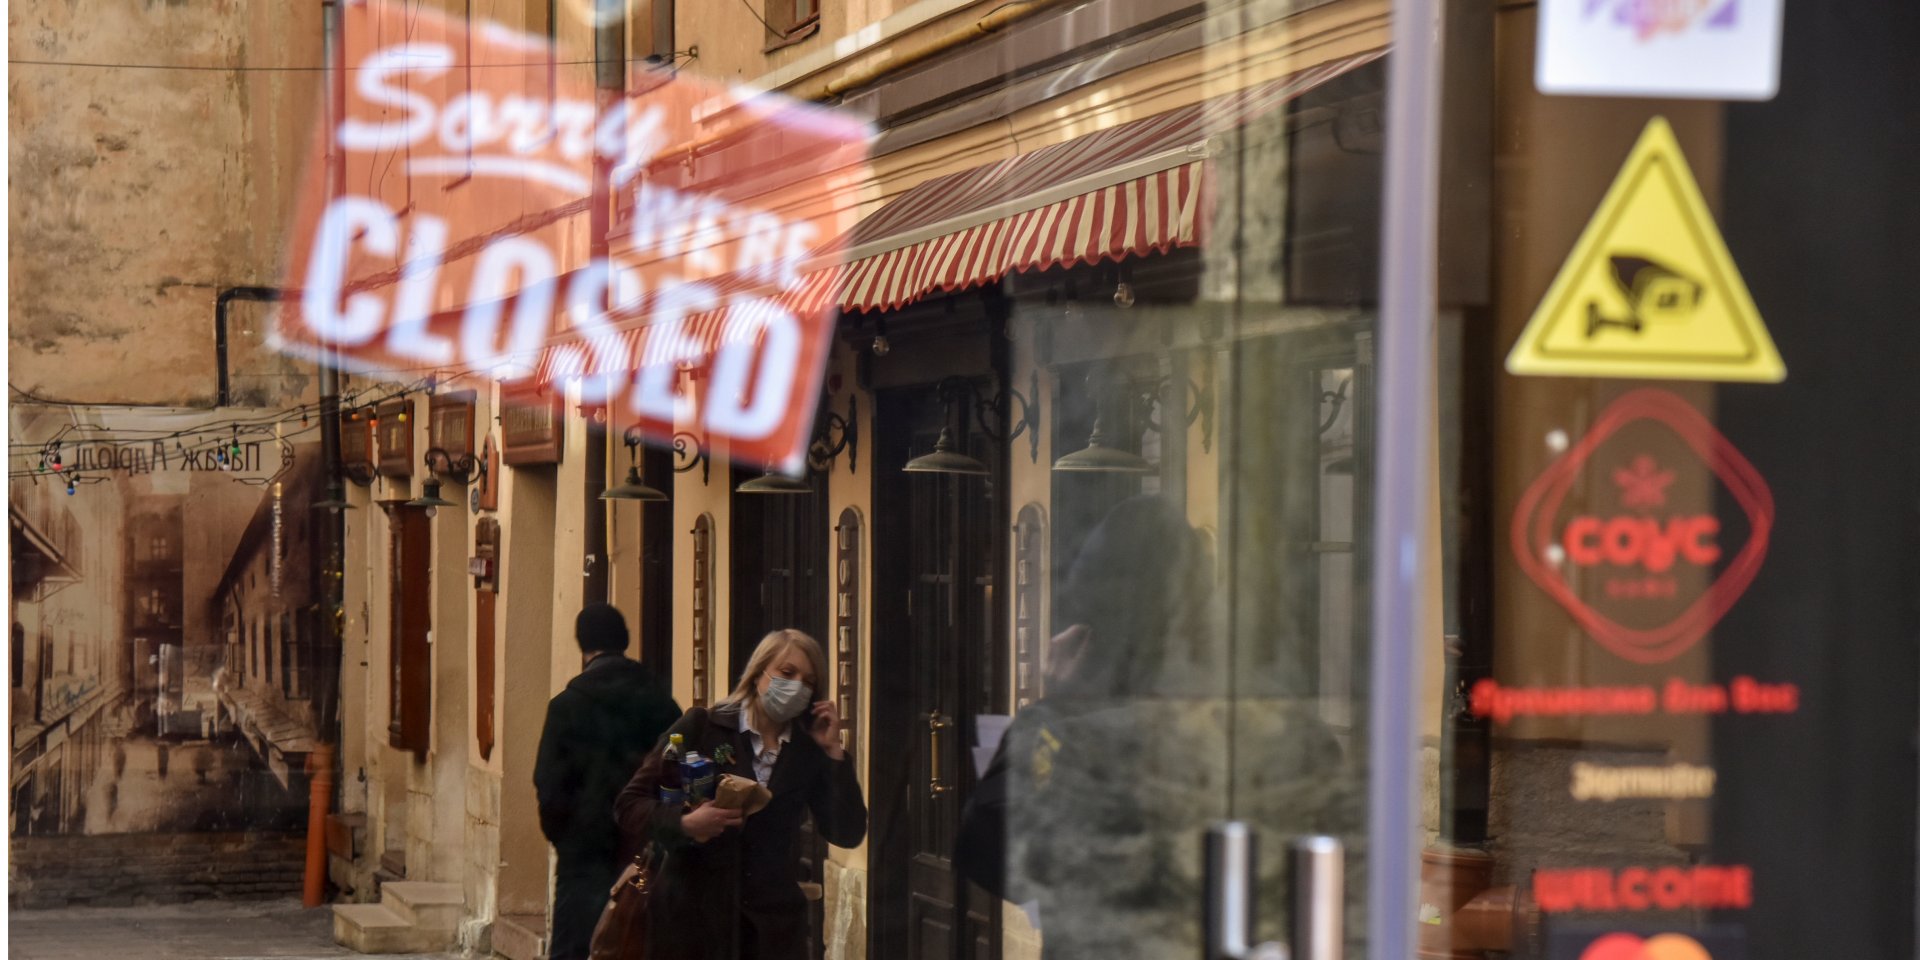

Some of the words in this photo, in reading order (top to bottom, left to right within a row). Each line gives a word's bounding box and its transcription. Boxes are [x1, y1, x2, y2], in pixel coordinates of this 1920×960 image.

[336, 42, 669, 187] Sorry
[301, 197, 800, 440] CLOSED
[1532, 865, 1752, 911] WELCOME
